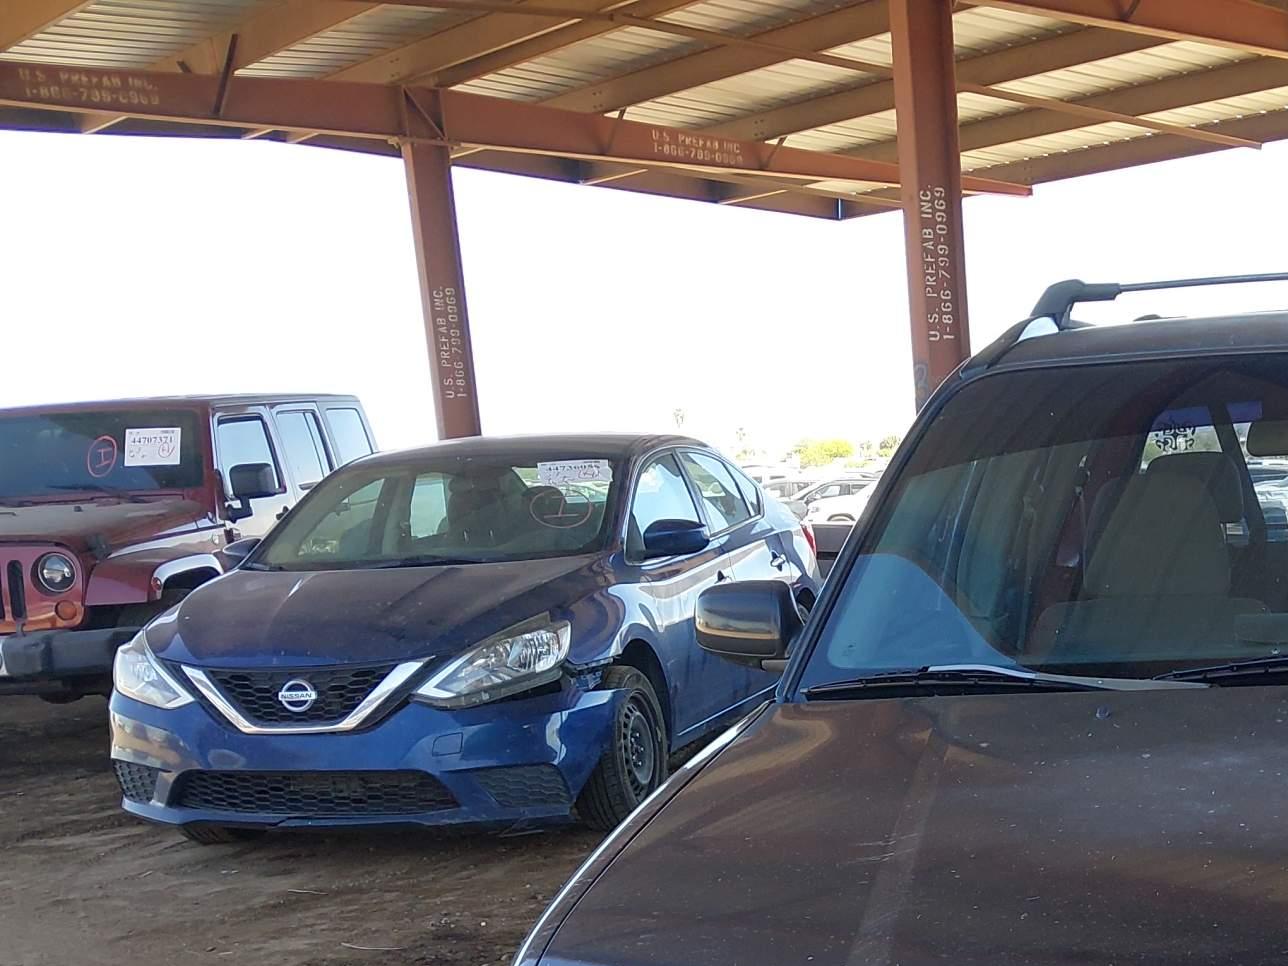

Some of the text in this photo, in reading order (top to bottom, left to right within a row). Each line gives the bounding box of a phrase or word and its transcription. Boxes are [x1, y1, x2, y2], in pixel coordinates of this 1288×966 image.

[919, 184, 940, 341] U.S. PREFAB INC.
[934, 187, 954, 340] 1-866-799-0969
[436, 318, 452, 367] PREFAB
[444, 375, 455, 399] U.S.
